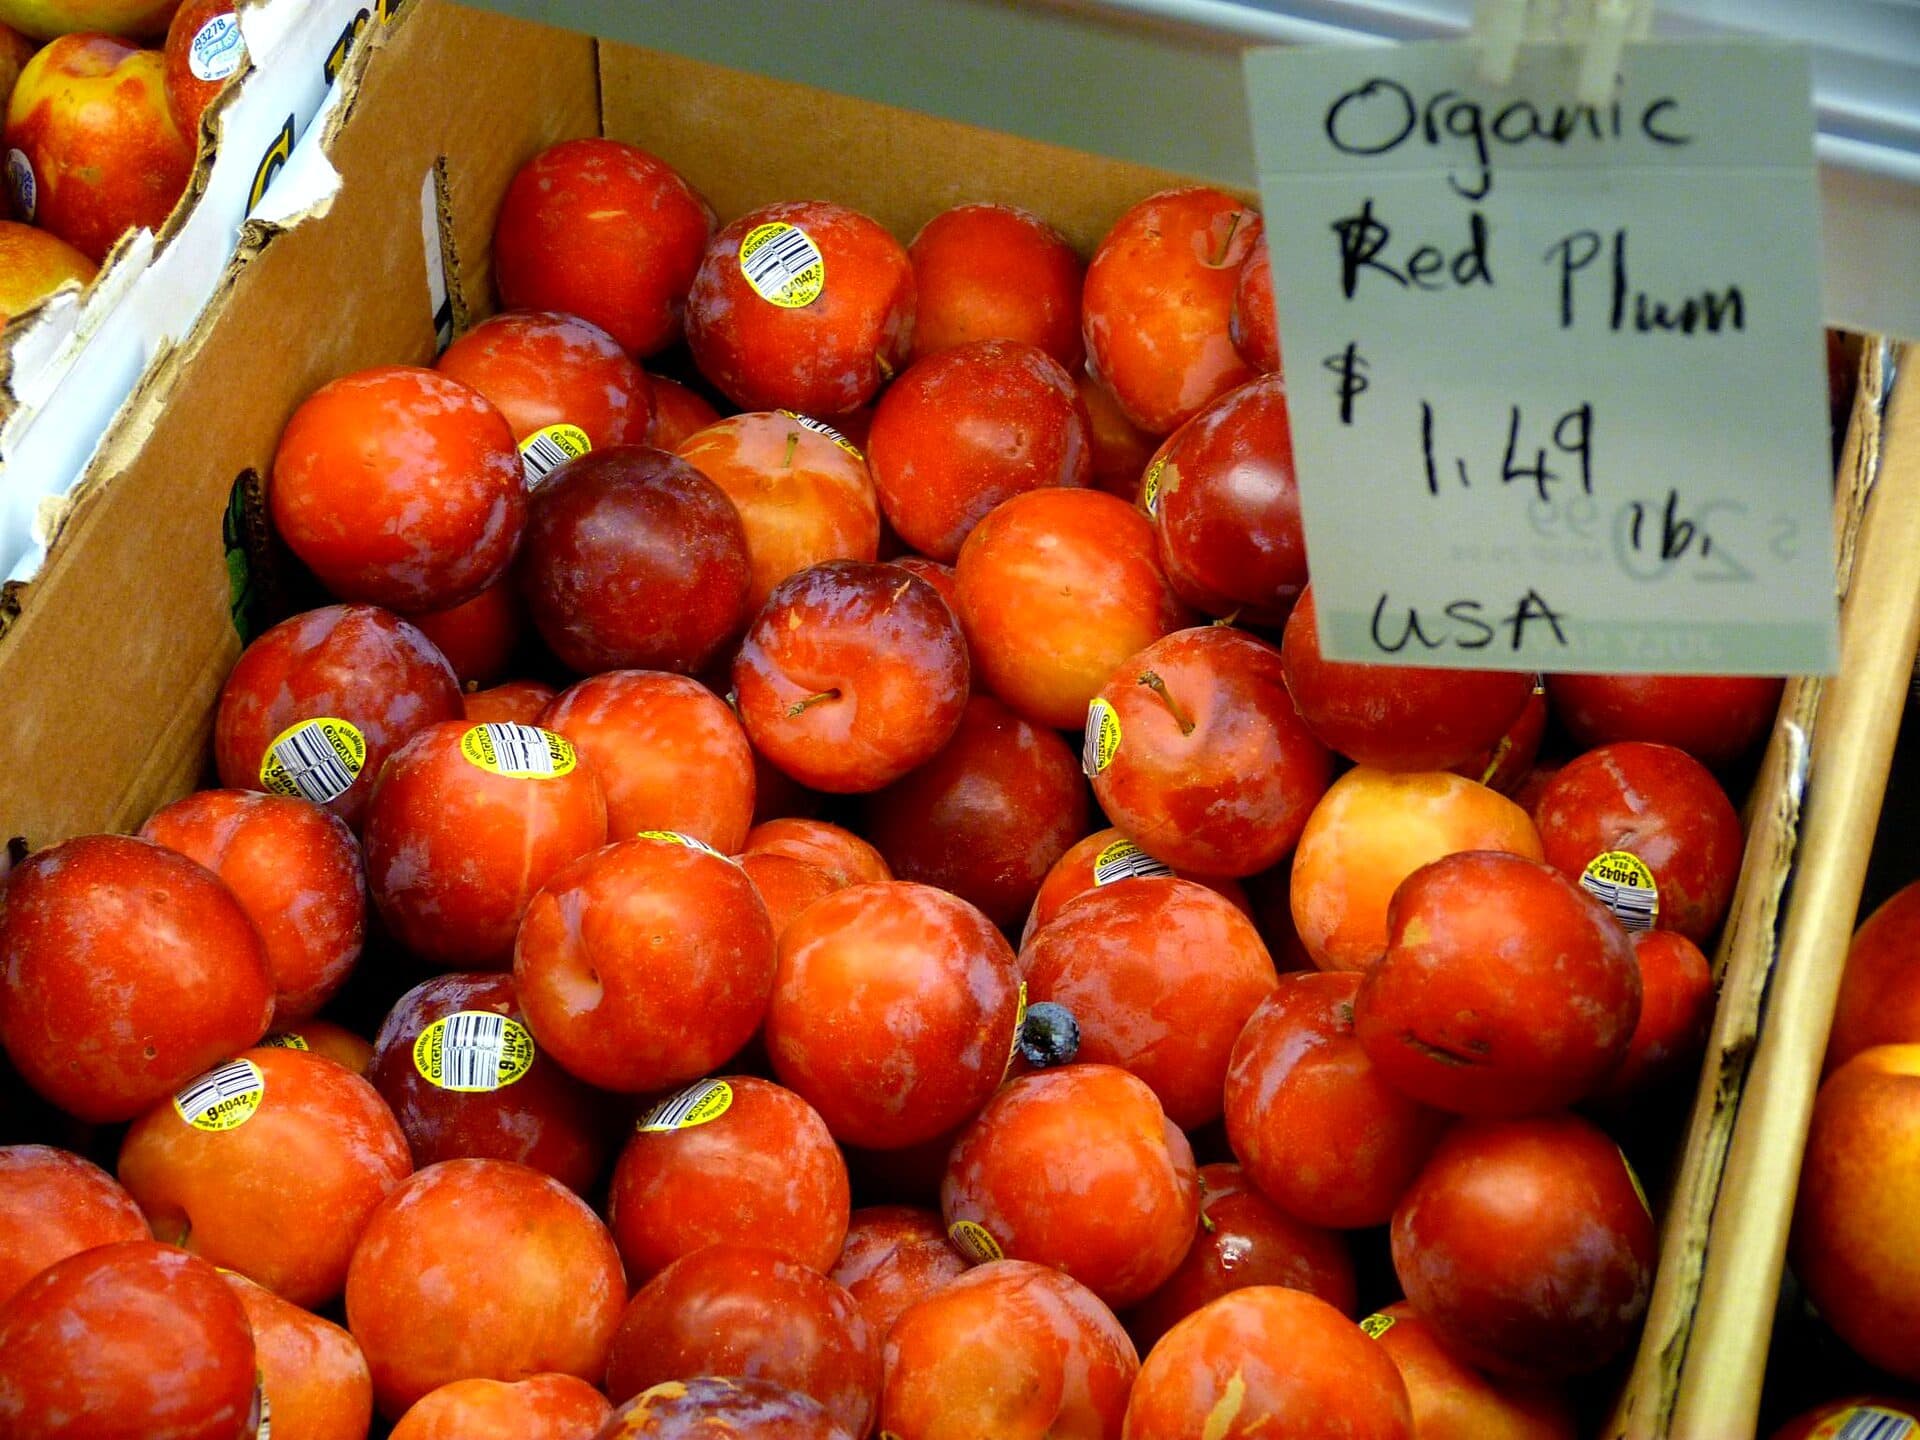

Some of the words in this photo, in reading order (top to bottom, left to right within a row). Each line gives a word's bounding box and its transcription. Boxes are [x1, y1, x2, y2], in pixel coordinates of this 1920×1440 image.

[1325, 75, 1692, 199] Organic
[744, 226, 787, 258] ORGANIC
[1331, 200, 1494, 298] Red
[1545, 230, 1746, 334] Plum
[1322, 341, 1369, 425] $
[551, 431, 580, 459] ORGA
[1421, 401, 1595, 500] 1.49
[1372, 589, 1568, 653] USA
[323, 725, 361, 772] ORGANIC
[1098, 714, 1110, 768] ORGANIC
[1599, 865, 1638, 887] 94042
[432, 1024, 444, 1078] ORGANIC
[499, 1031, 517, 1070] 94042
[207, 1094, 249, 1121] 94042
